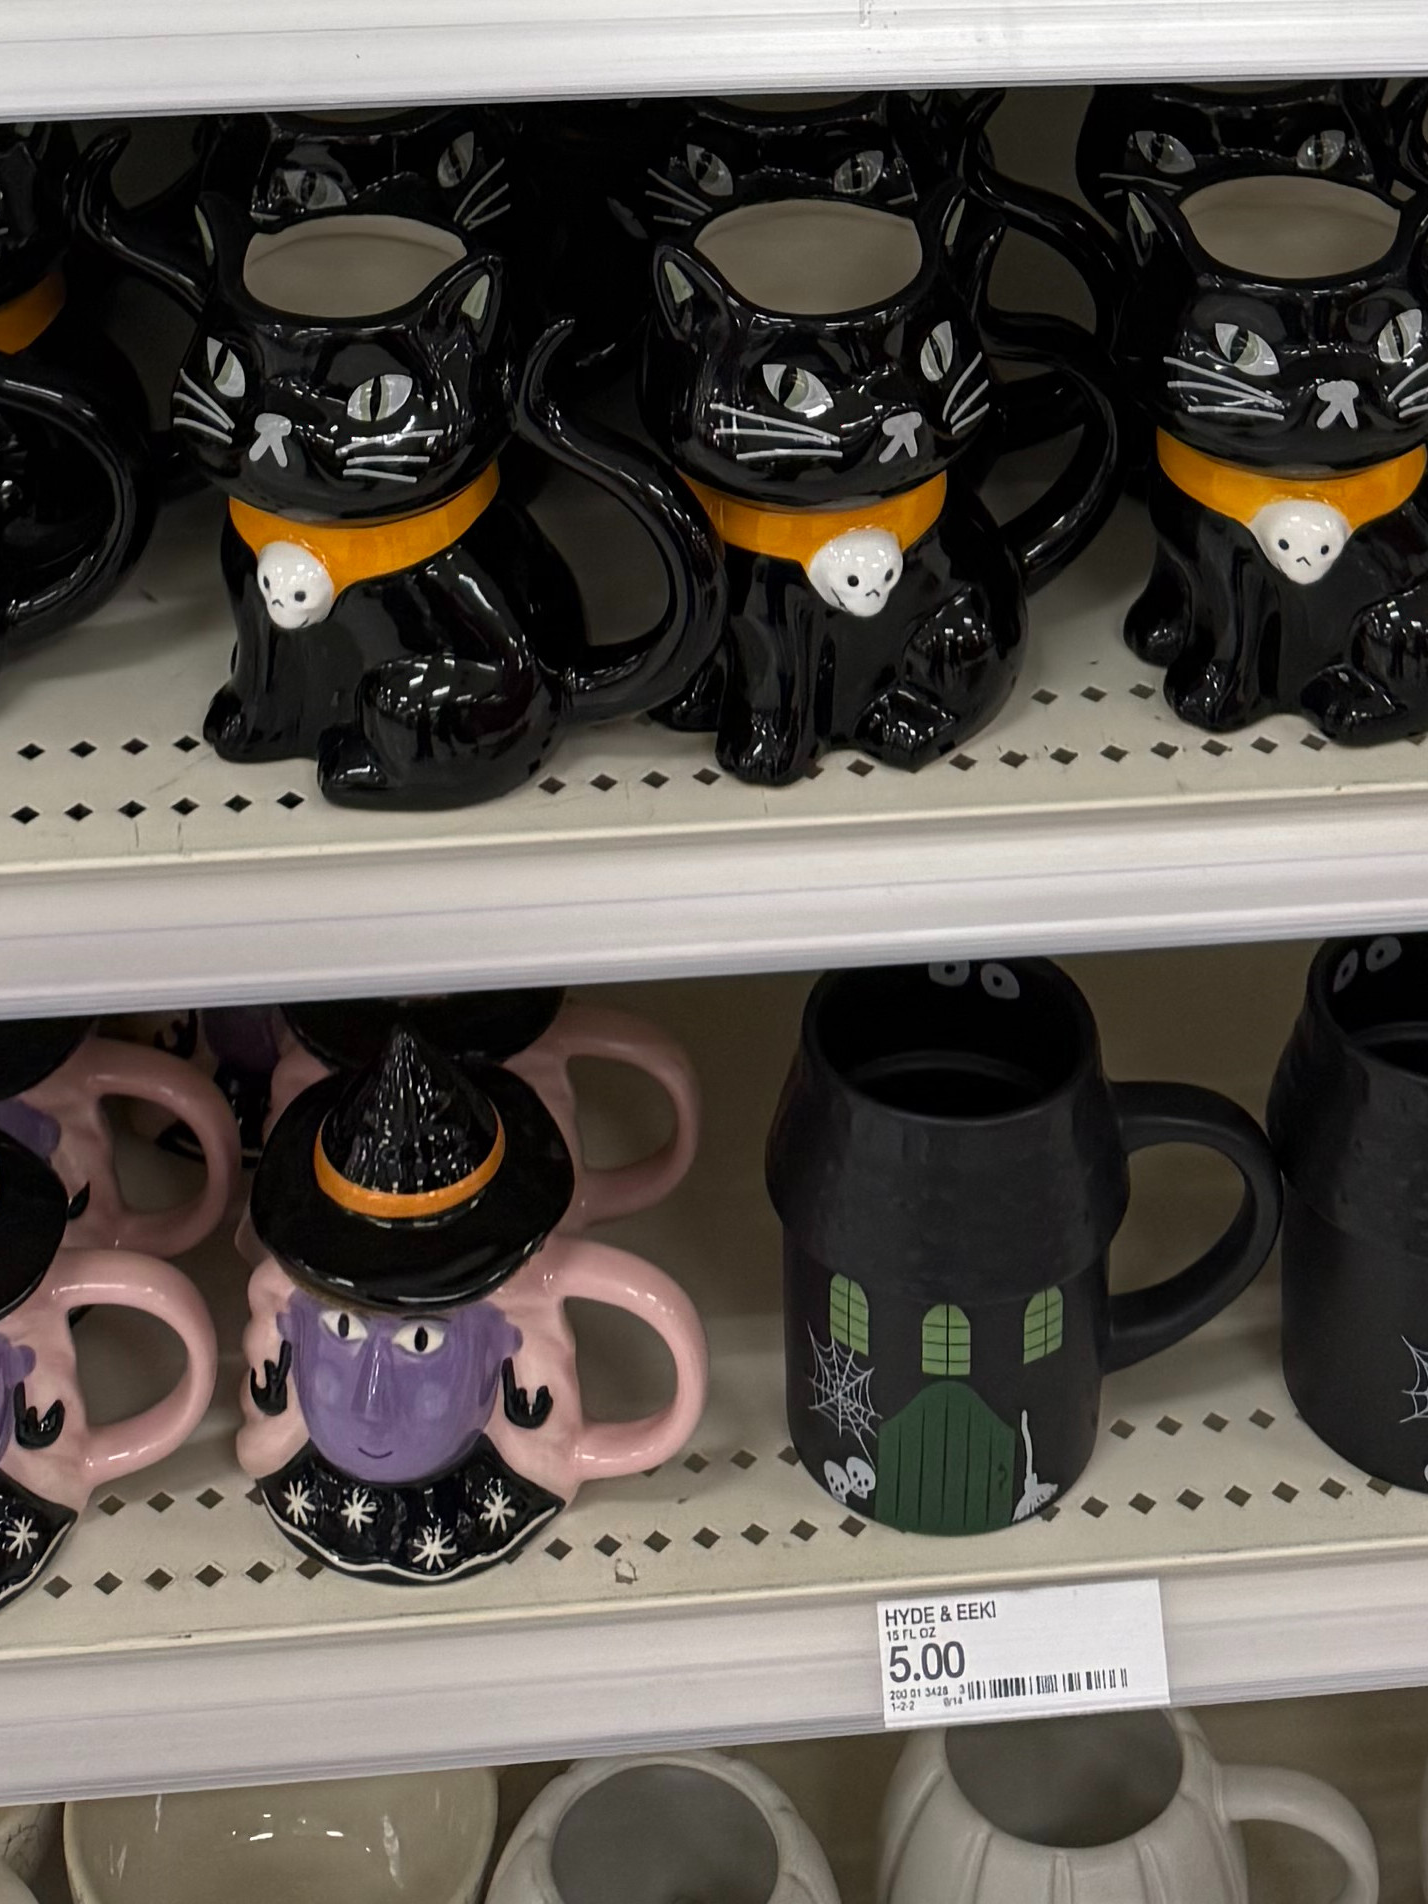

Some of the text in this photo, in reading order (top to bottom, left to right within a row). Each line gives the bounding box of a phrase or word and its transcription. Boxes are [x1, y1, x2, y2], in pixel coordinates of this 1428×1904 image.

[885, 1606, 935, 1626] HYDE
[940, 1605, 952, 1622] &
[903, 1629, 916, 1640] FL
[920, 1627, 936, 1638] OZ
[889, 1641, 966, 1682] 5.00
